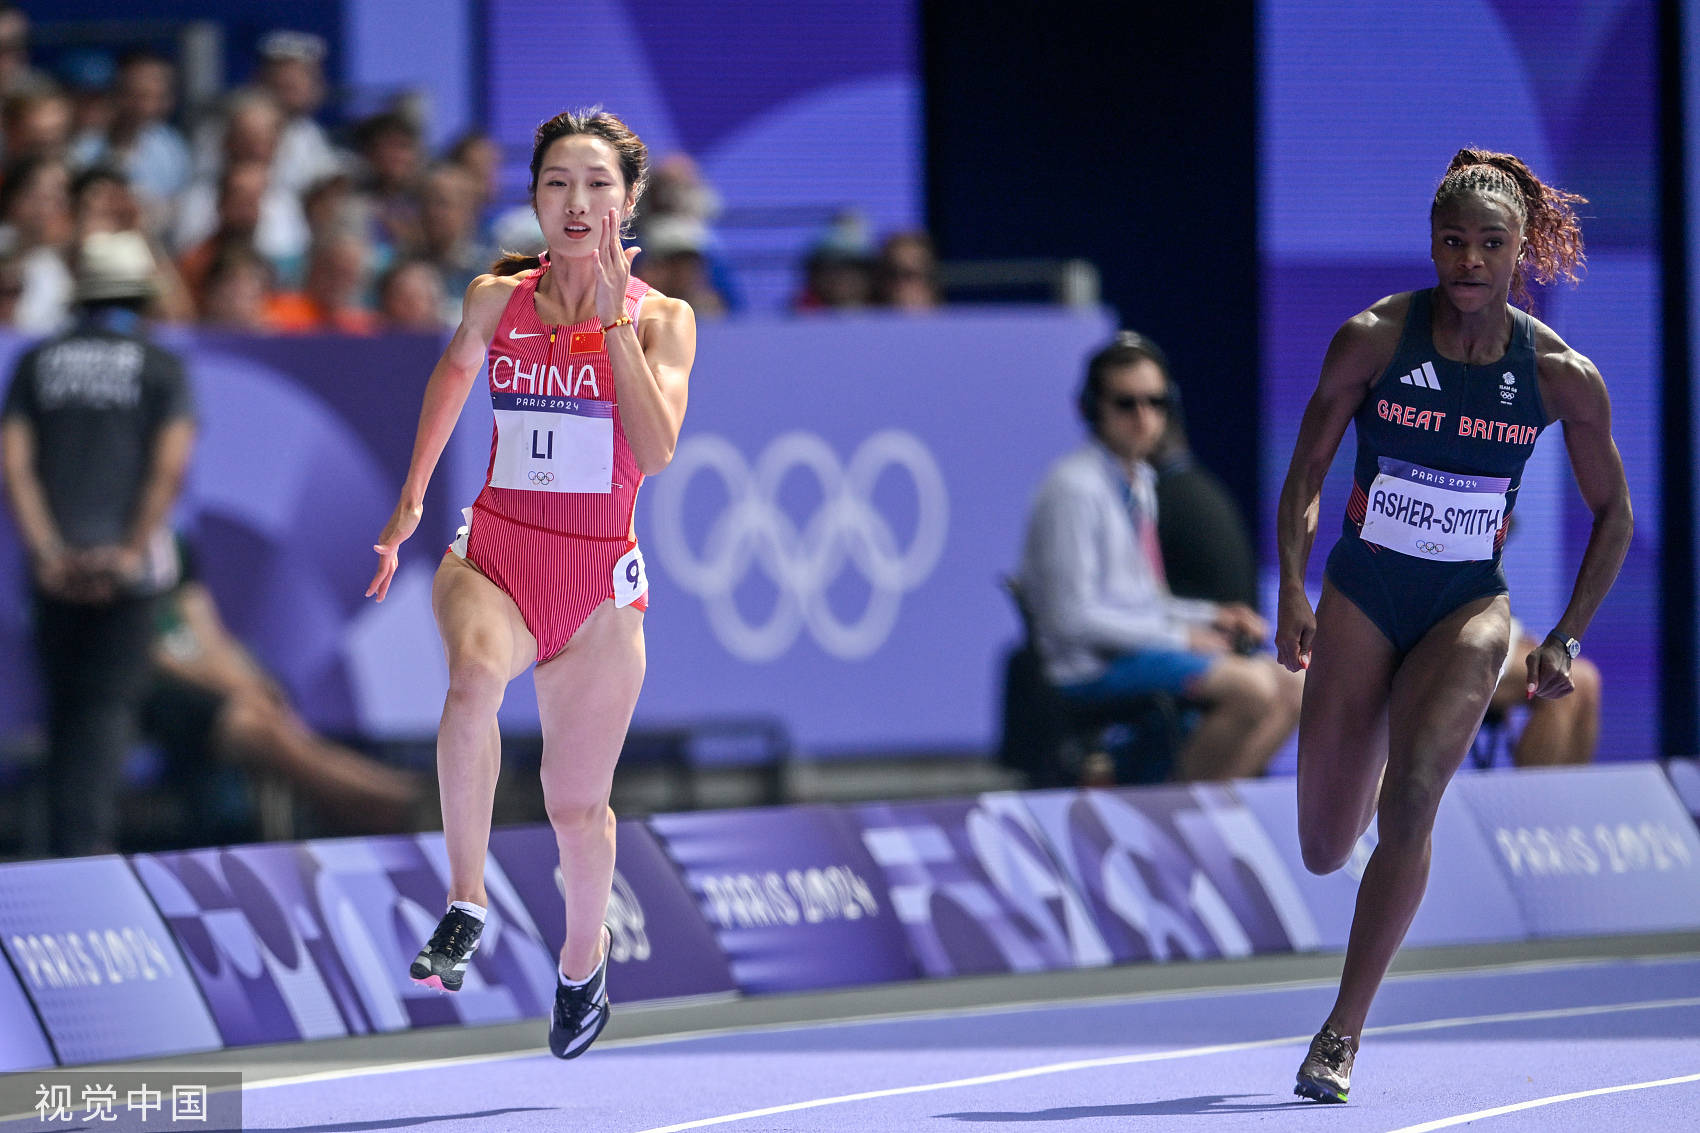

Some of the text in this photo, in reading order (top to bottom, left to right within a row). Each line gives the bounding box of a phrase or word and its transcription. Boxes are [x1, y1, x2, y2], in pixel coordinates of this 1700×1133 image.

[493, 356, 599, 397] CHINA
[516, 397, 579, 411] PARIS 2024
[1377, 399, 1538, 445] GREAT BRITAIN
[531, 429, 554, 459] LI
[1411, 469, 1478, 489] PARIS 2024
[1372, 490, 1500, 536] ASHER-SMITH
[625, 559, 640, 590] 9
[1496, 822, 1692, 877] PARIS 2024
[703, 865, 879, 929] PARIS 2024
[12, 926, 173, 989] PARIS 2024
